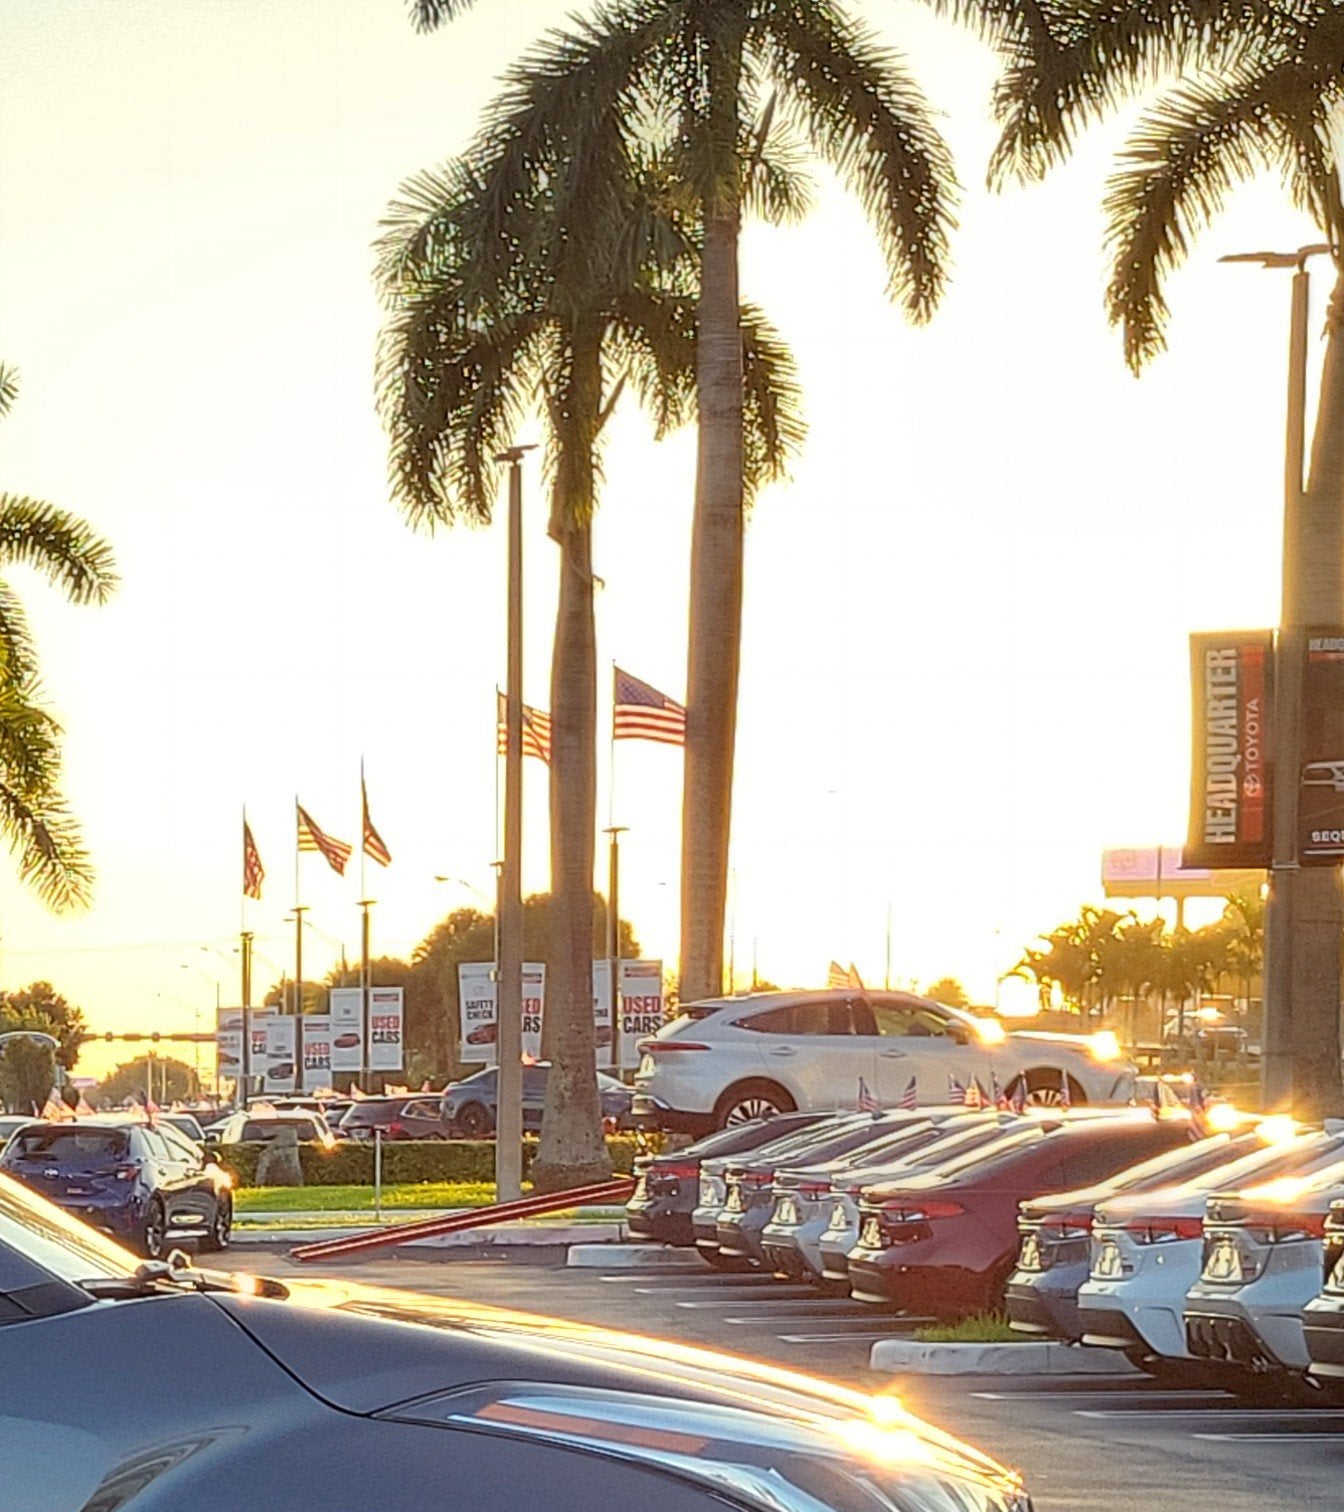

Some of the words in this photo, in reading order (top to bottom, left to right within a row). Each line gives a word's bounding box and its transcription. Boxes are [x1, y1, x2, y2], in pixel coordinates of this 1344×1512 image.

[1245, 698, 1260, 772] TOYOTA
[1204, 648, 1241, 843] HEADQUARTER
[1312, 830, 1344, 843] SEQ
[623, 996, 661, 1014] USED
[371, 1015, 400, 1029] USED
[623, 1016, 661, 1034] CARS
[371, 1031, 400, 1044] CARS
[304, 1043, 330, 1056] USED
[304, 1057, 331, 1071] CARS
